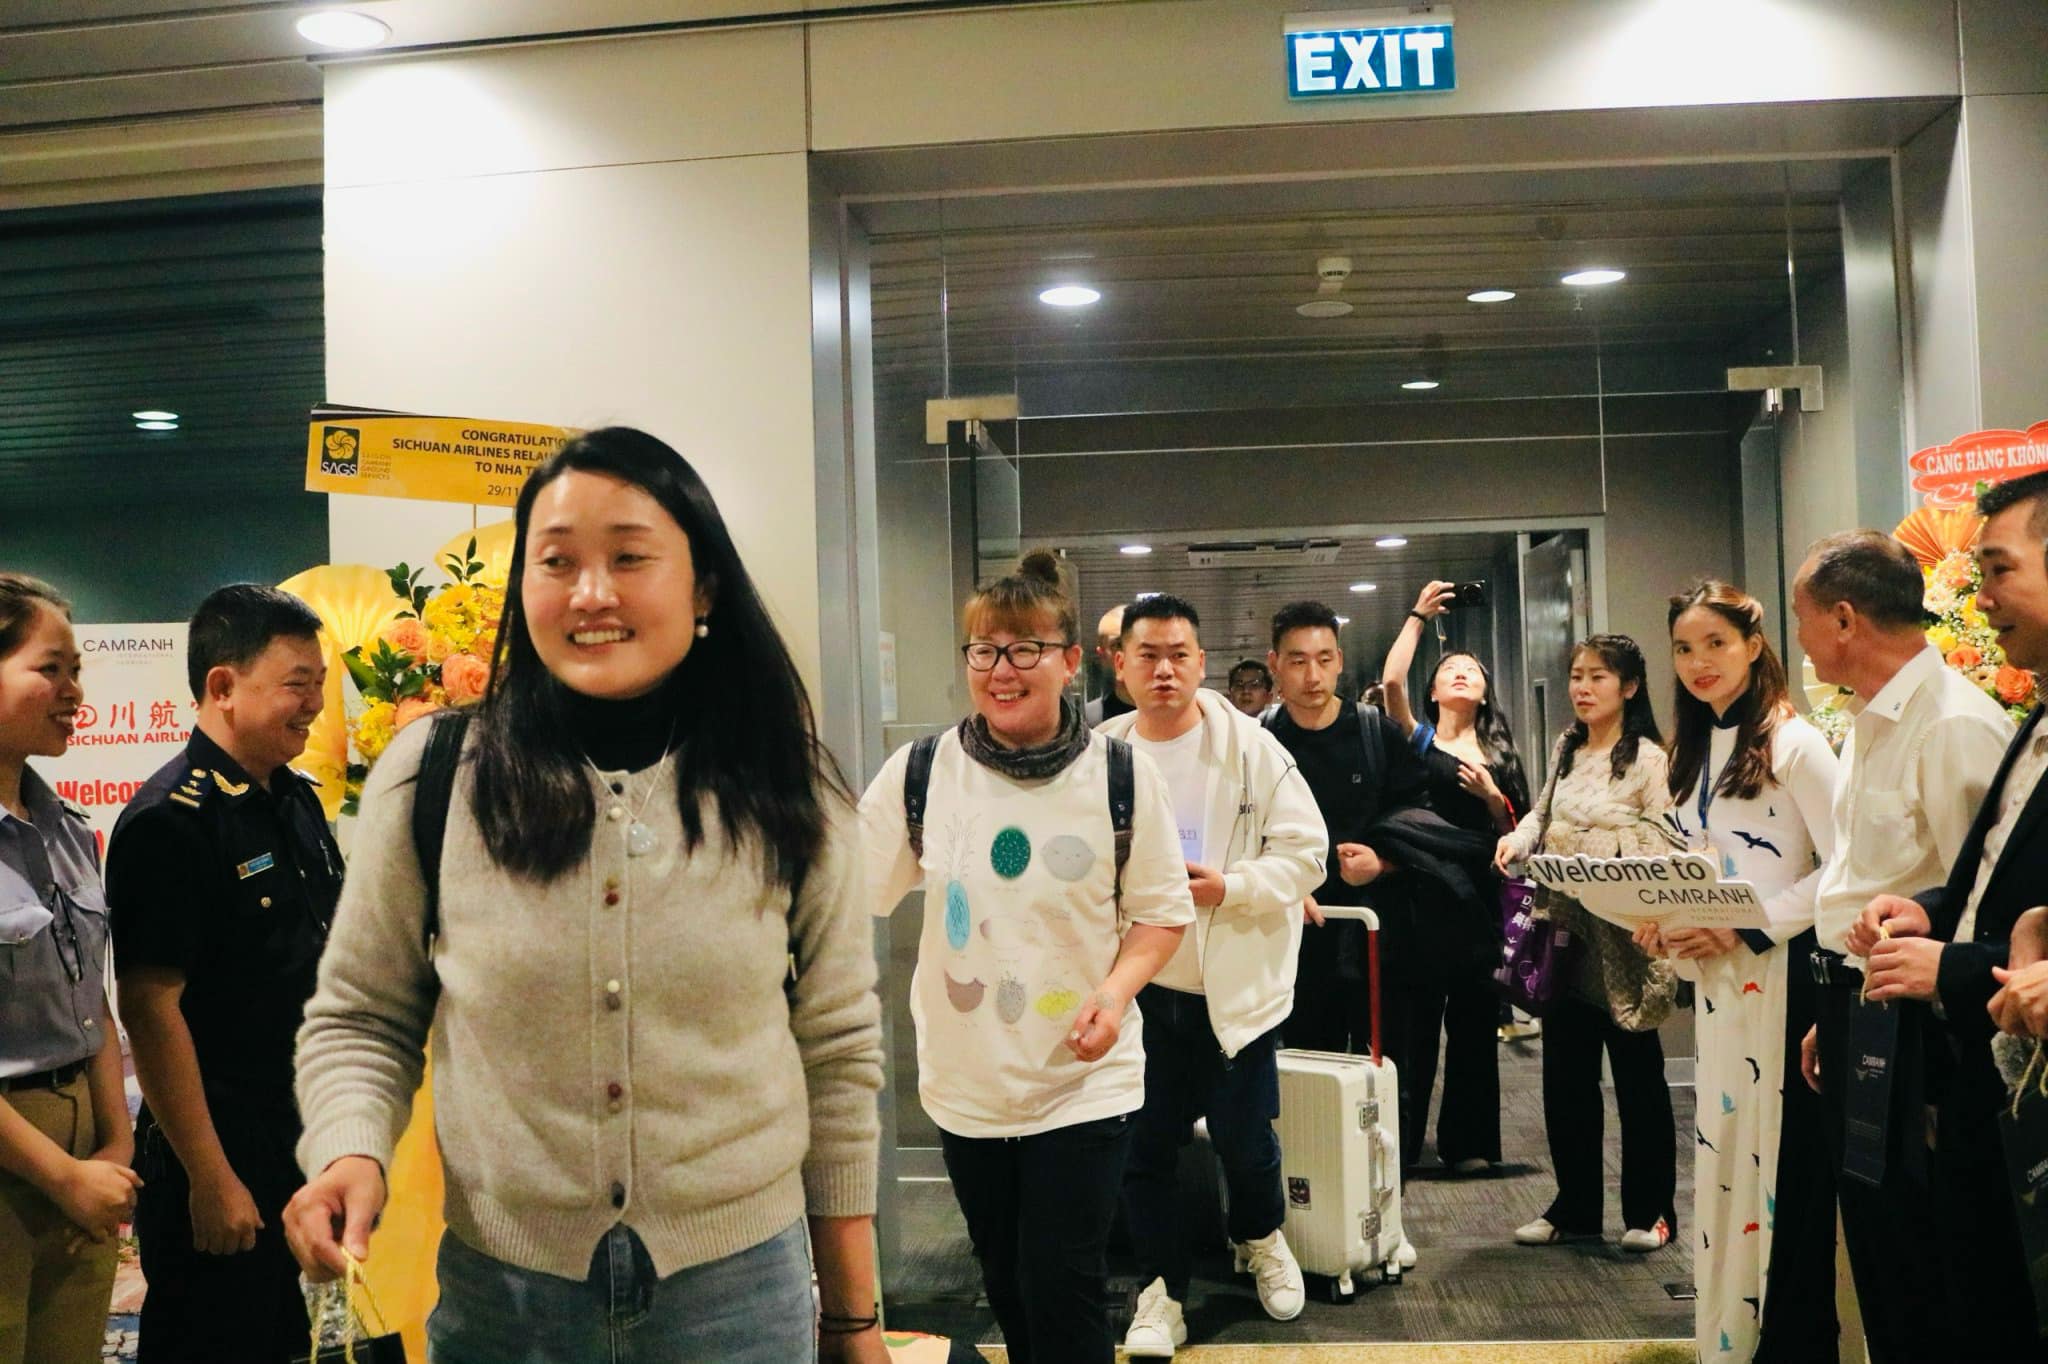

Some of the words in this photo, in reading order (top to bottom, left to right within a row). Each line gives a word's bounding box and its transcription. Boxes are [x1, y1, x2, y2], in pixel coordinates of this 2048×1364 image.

[1295, 32, 1445, 91] EXIT
[462, 429, 568, 449] CONGRATULATIO
[392, 438, 450, 454] SICHUAN
[454, 444, 510, 459] AIRLINES
[321, 461, 357, 477] SAGS
[475, 461, 492, 473] TO
[496, 463, 522, 476] NHA
[487, 484, 519, 497] 29/11
[83, 639, 174, 652] CAMRANH
[72, 700, 200, 729] 四川航
[66, 732, 139, 746] SICHUAN
[143, 730, 192, 743] AIRLIN
[56, 779, 146, 806] Welco
[1534, 858, 1668, 883] Welcome
[1672, 858, 1706, 880] to
[1638, 889, 1754, 905] CAMRANH
